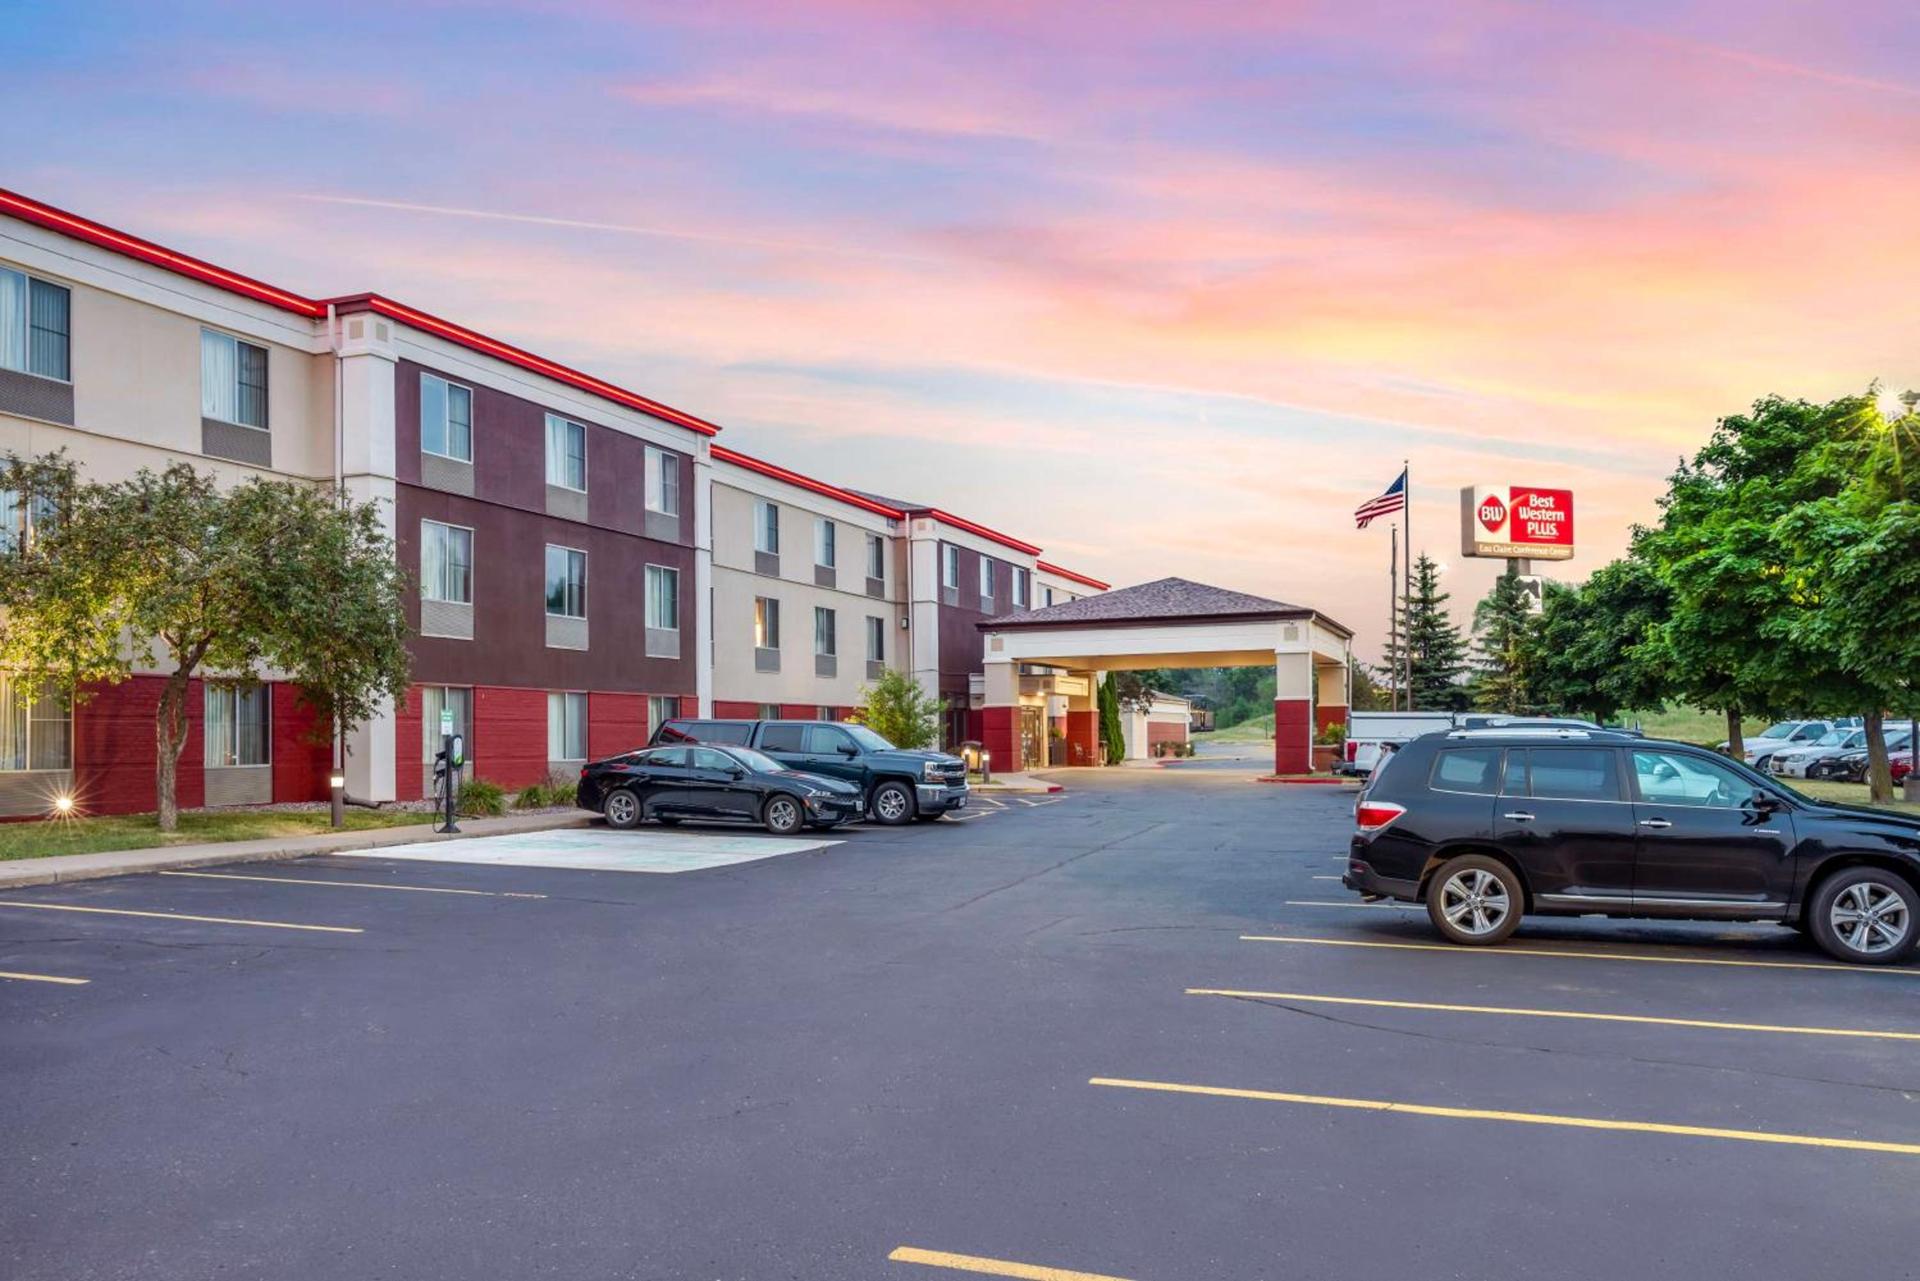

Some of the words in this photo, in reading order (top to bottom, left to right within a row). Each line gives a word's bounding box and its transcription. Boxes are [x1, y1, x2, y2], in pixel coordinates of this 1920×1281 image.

[1529, 494, 1555, 508] Best
[1481, 506, 1503, 521] BW
[1518, 506, 1565, 521] Western
[1527, 521, 1557, 536] PLUS
